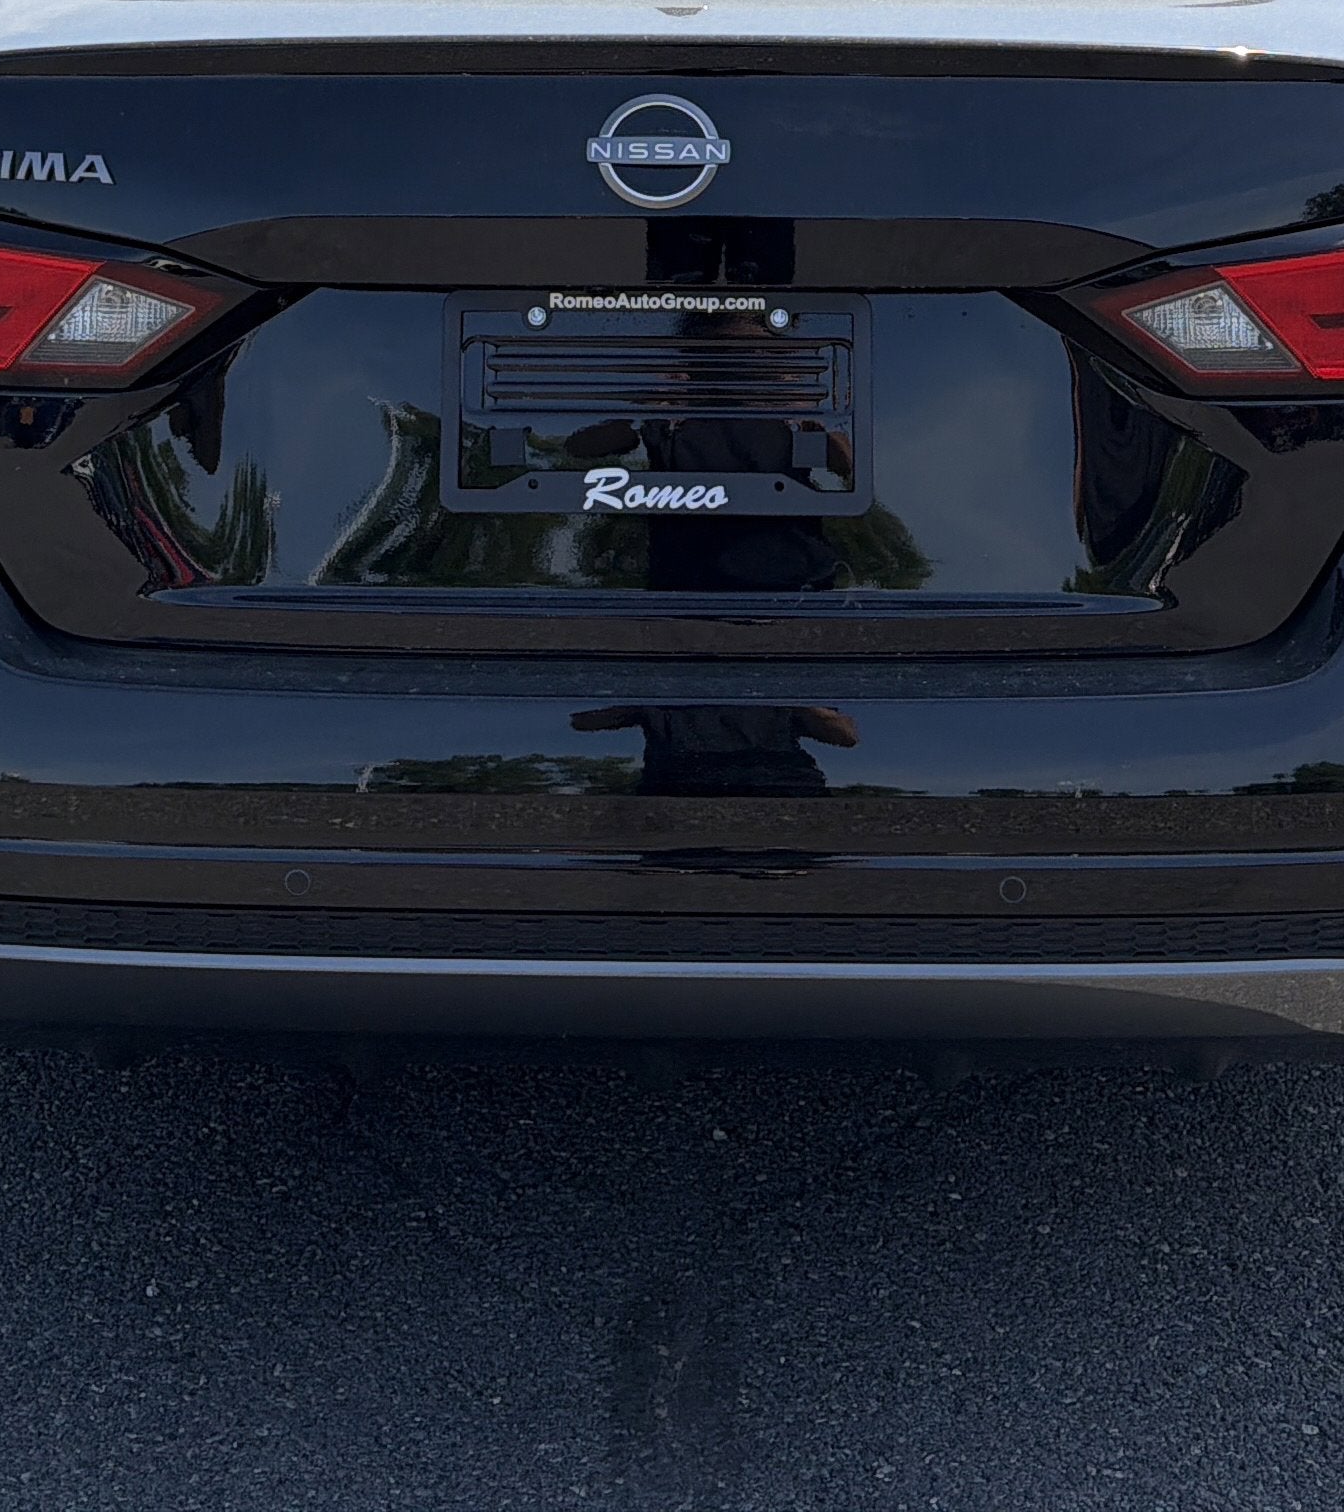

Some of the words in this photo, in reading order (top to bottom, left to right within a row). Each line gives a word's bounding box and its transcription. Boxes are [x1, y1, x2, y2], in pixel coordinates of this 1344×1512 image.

[590, 142, 727, 161] NISSAN
[549, 292, 766, 314] RomeoAutoGroup.com
[582, 467, 729, 511] Romeo
